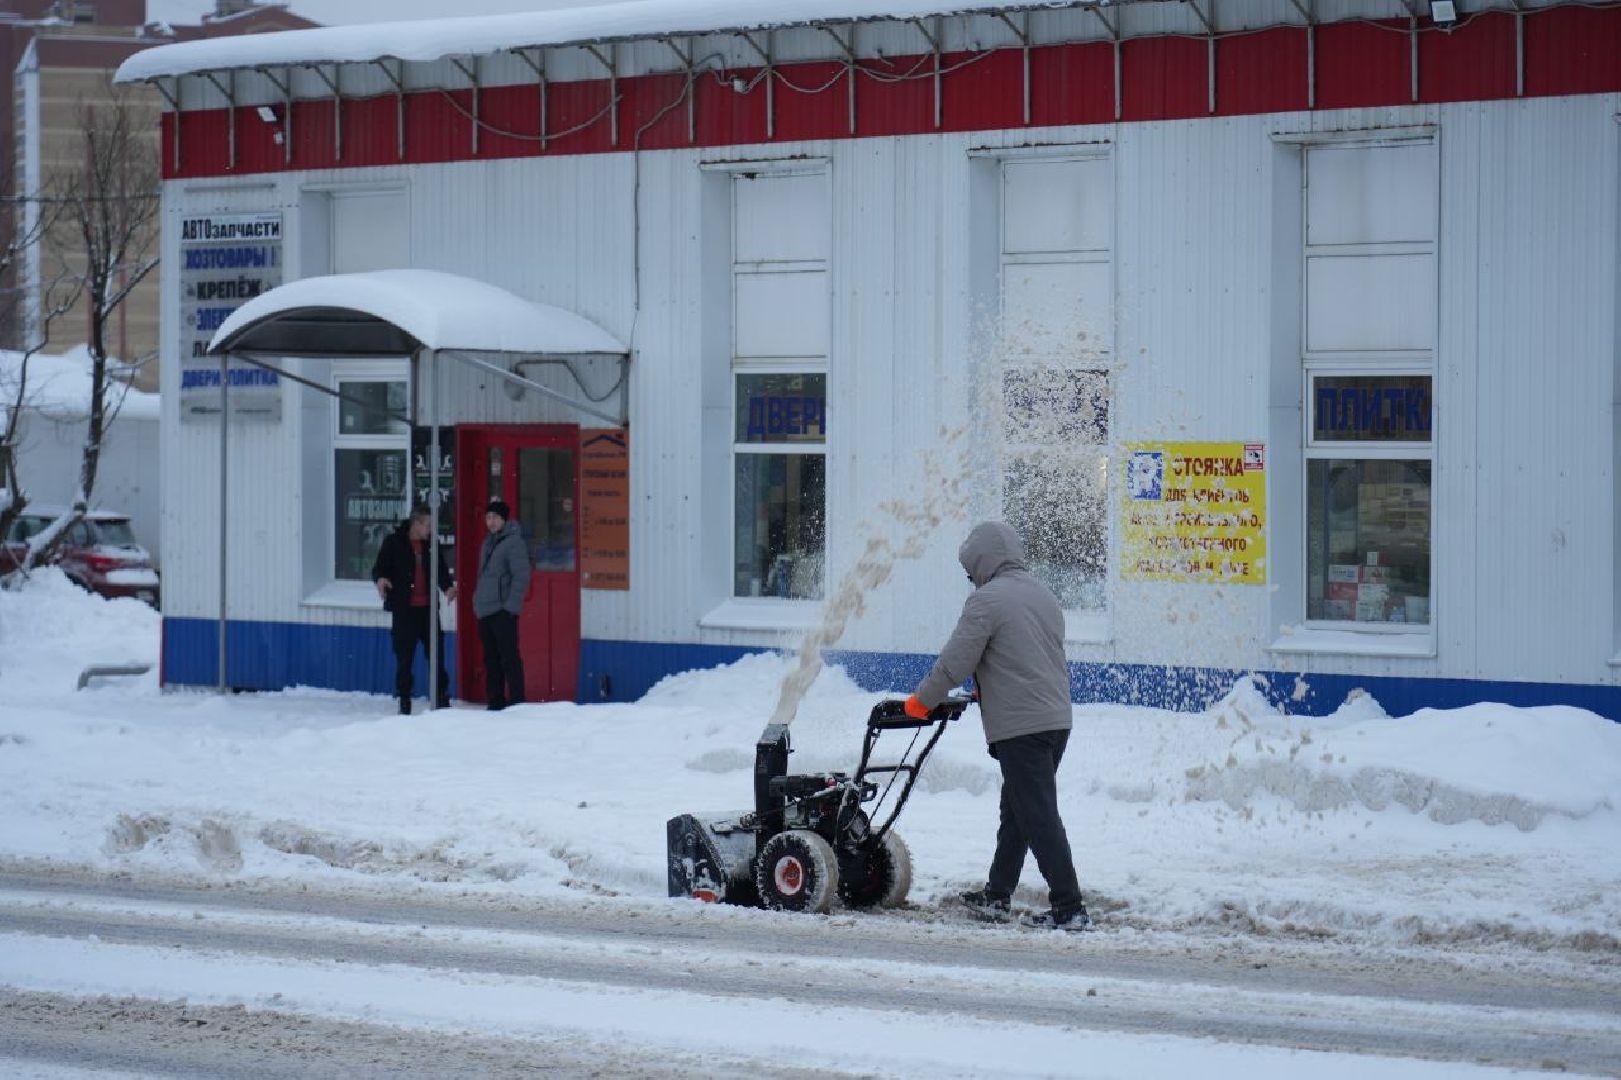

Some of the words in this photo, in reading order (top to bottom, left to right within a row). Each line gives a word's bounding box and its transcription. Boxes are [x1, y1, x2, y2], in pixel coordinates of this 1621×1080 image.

[186, 246, 265, 269] ХОЗТОВАРЫ
[197, 276, 262, 300] КРЕПЁЖ
[182, 369, 221, 389] ДВЕРИ
[1317, 387, 1432, 431] ПЛИТК
